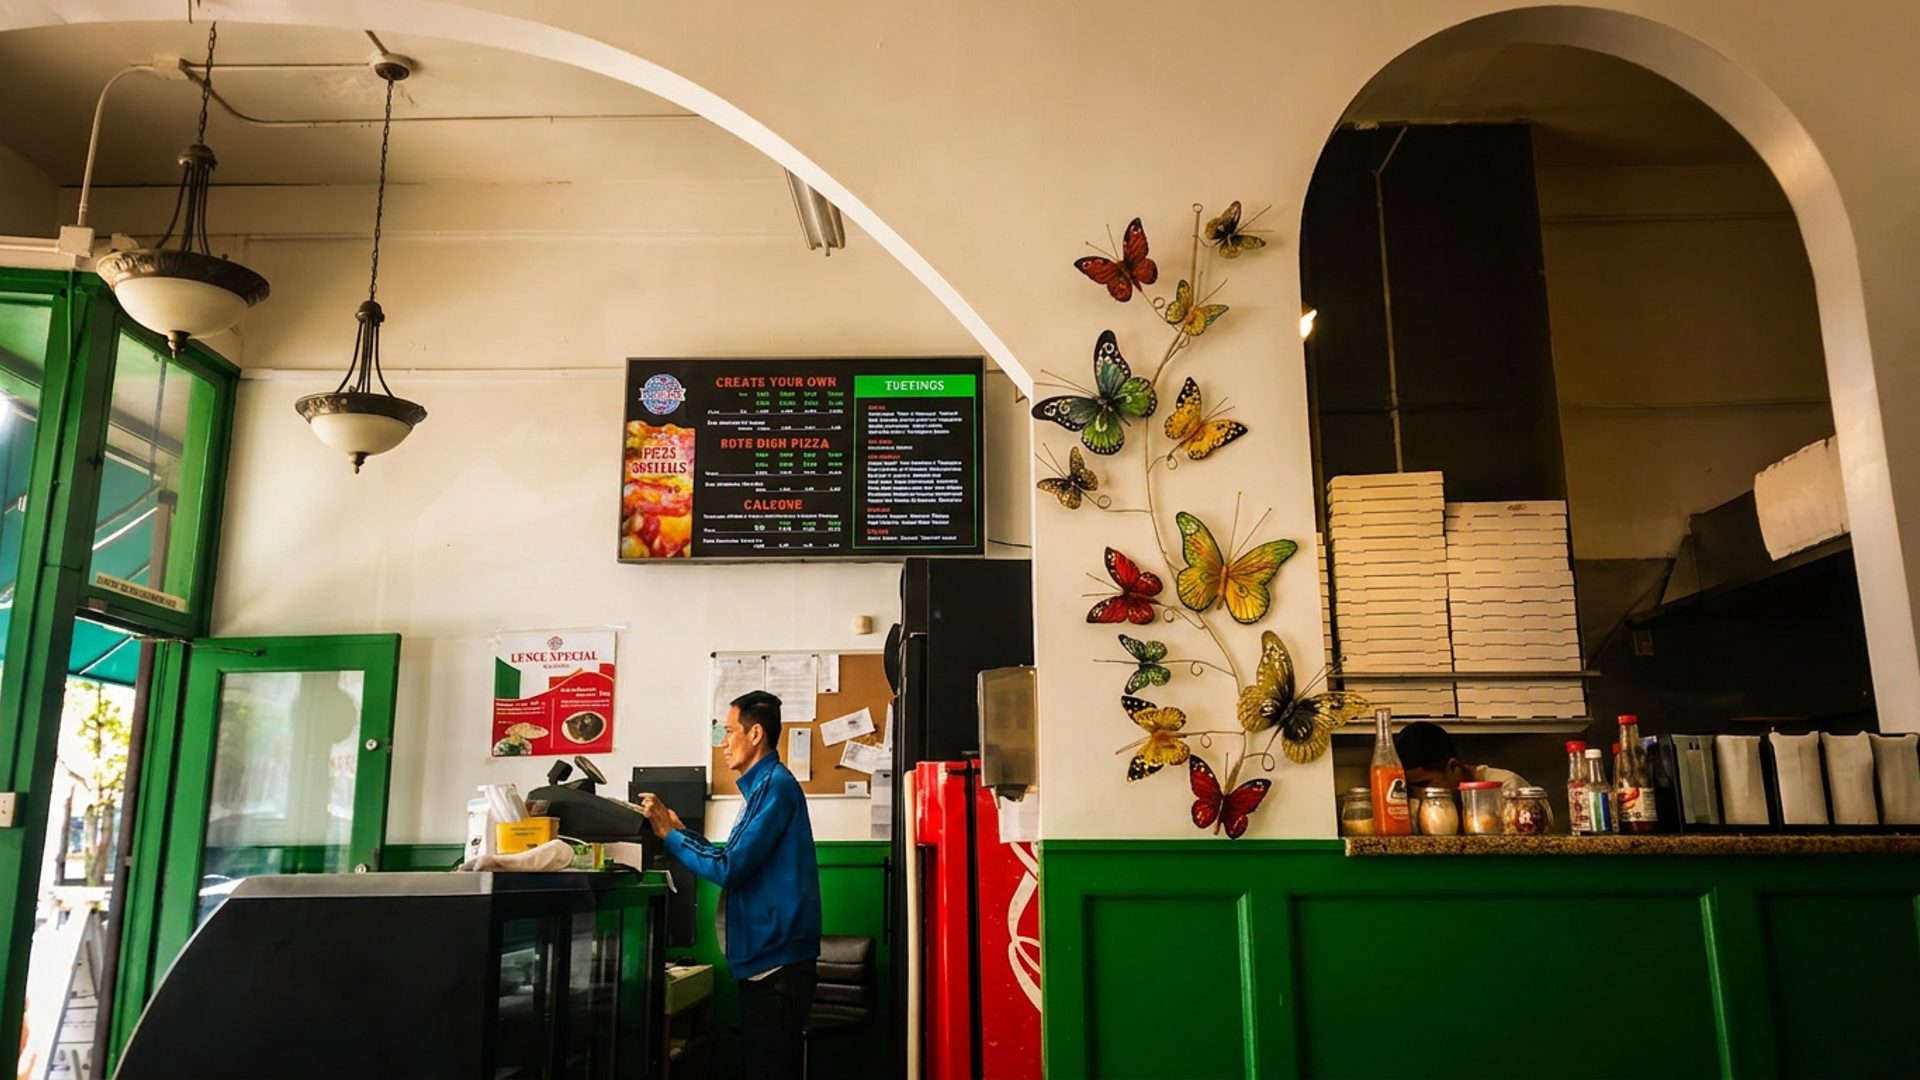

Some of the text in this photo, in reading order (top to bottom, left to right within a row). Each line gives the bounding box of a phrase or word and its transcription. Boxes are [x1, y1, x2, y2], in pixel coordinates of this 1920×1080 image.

[715, 376, 766, 388] CREATE
[769, 376, 804, 388] YOUR
[791, 438, 830, 449] PIZZA
